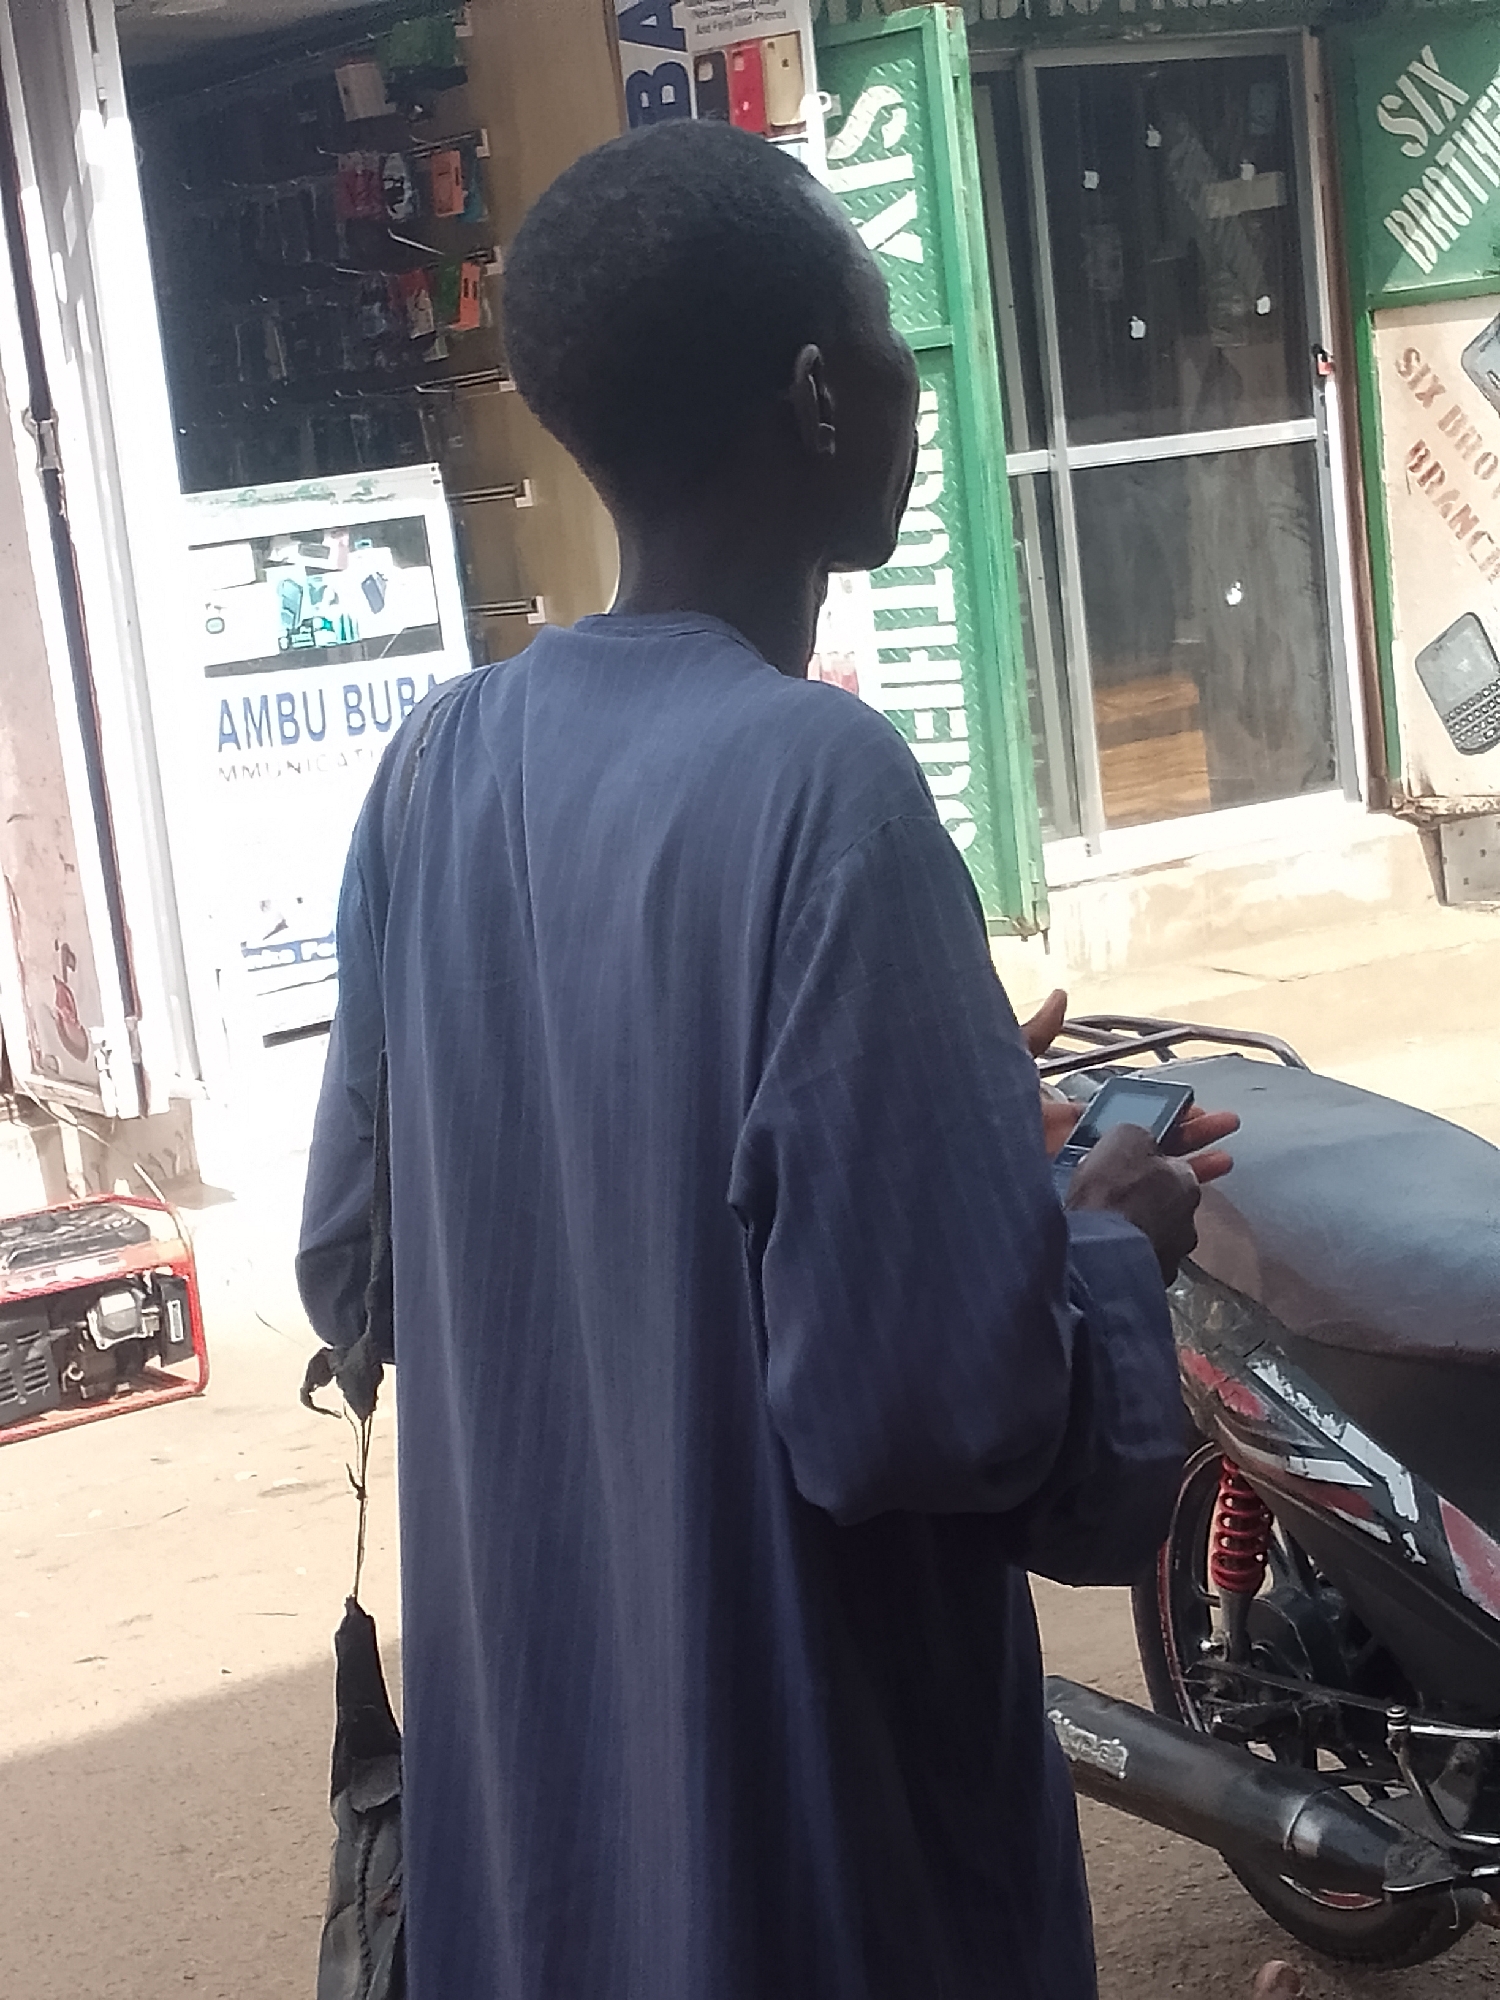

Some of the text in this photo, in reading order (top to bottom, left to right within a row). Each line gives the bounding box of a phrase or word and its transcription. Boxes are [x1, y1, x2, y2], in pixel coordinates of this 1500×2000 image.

[1377, 45, 1469, 157] SIX
[827, 85, 924, 264] SIX
[1384, 62, 1500, 274] BROTHE
[1395, 347, 1500, 500] SIX BRO
[218, 688, 326, 752] AMBU
[218, 747, 386, 782] MMUNICATI
